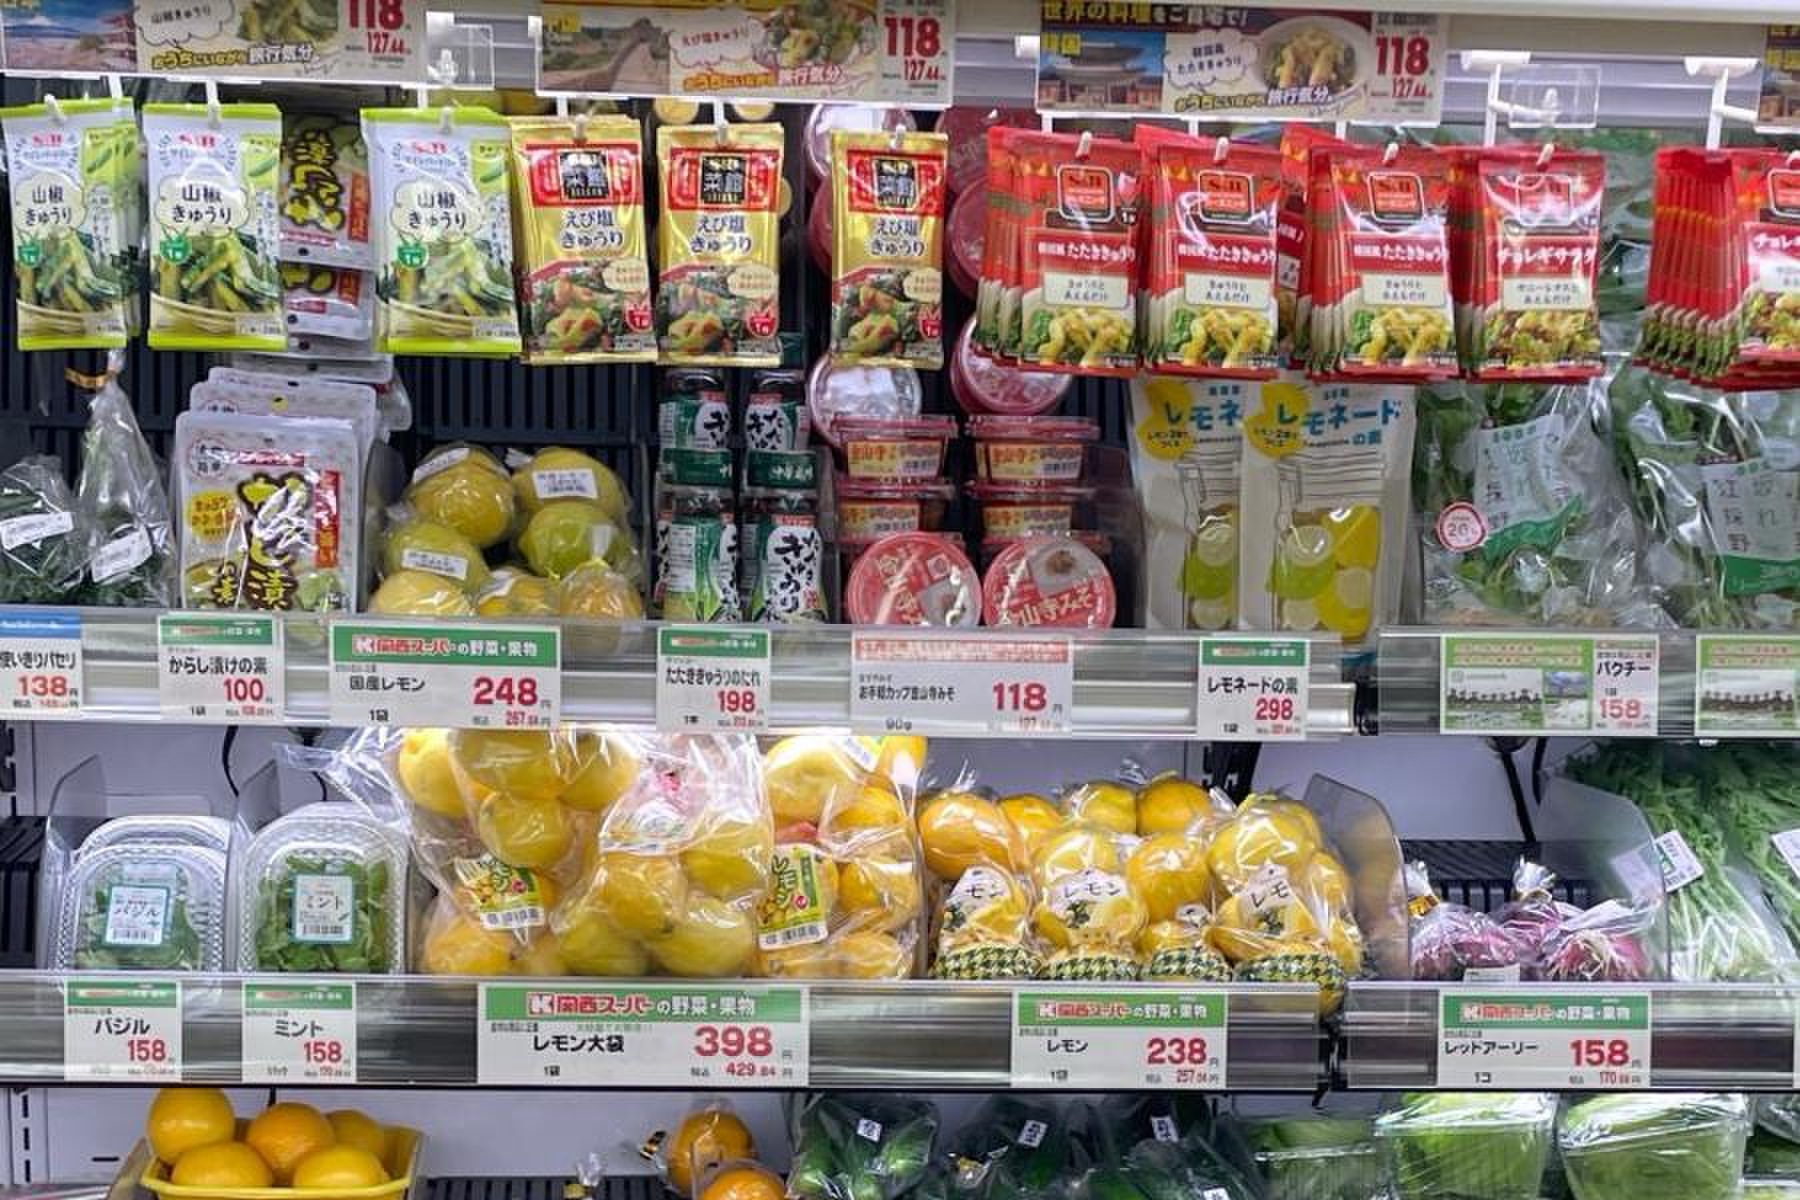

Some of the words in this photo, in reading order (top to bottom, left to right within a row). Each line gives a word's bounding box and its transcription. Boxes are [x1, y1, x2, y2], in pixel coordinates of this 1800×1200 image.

[884, 18, 942, 58] 118
[1375, 33, 1430, 75] 118
[25, 207, 72, 226] きゅうり
[171, 206, 233, 226] きゅうり
[408, 214, 468, 229] きゅうり
[561, 230, 624, 249] きゅうり
[690, 236, 752, 254] きゅうり
[870, 239, 925, 256] きゅうり
[1277, 399, 1401, 436] レモネード
[1596, 661, 1651, 677] パクチー
[18, 675, 68, 697] 138
[223, 678, 264, 702] 100
[349, 675, 426, 691] 国産レモン
[473, 676, 538, 705] 248
[1207, 677, 1298, 695] レモネードの素
[717, 690, 756, 713] 198
[993, 682, 1047, 711] 118
[1254, 698, 1293, 721] 298
[1599, 699, 1641, 719] 158
[1062, 880, 1121, 898] レモン
[94, 1018, 150, 1035] バジル
[274, 1019, 325, 1037] ミント
[128, 1039, 166, 1061] 158
[533, 1034, 625, 1053] レモン大袋
[693, 1025, 773, 1057] 398
[1047, 1039, 1089, 1053] レモン
[1146, 1037, 1207, 1065] 238
[1443, 1040, 1539, 1056] レッドアーリー
[303, 1041, 342, 1063] 158
[1569, 1039, 1630, 1067] 158
